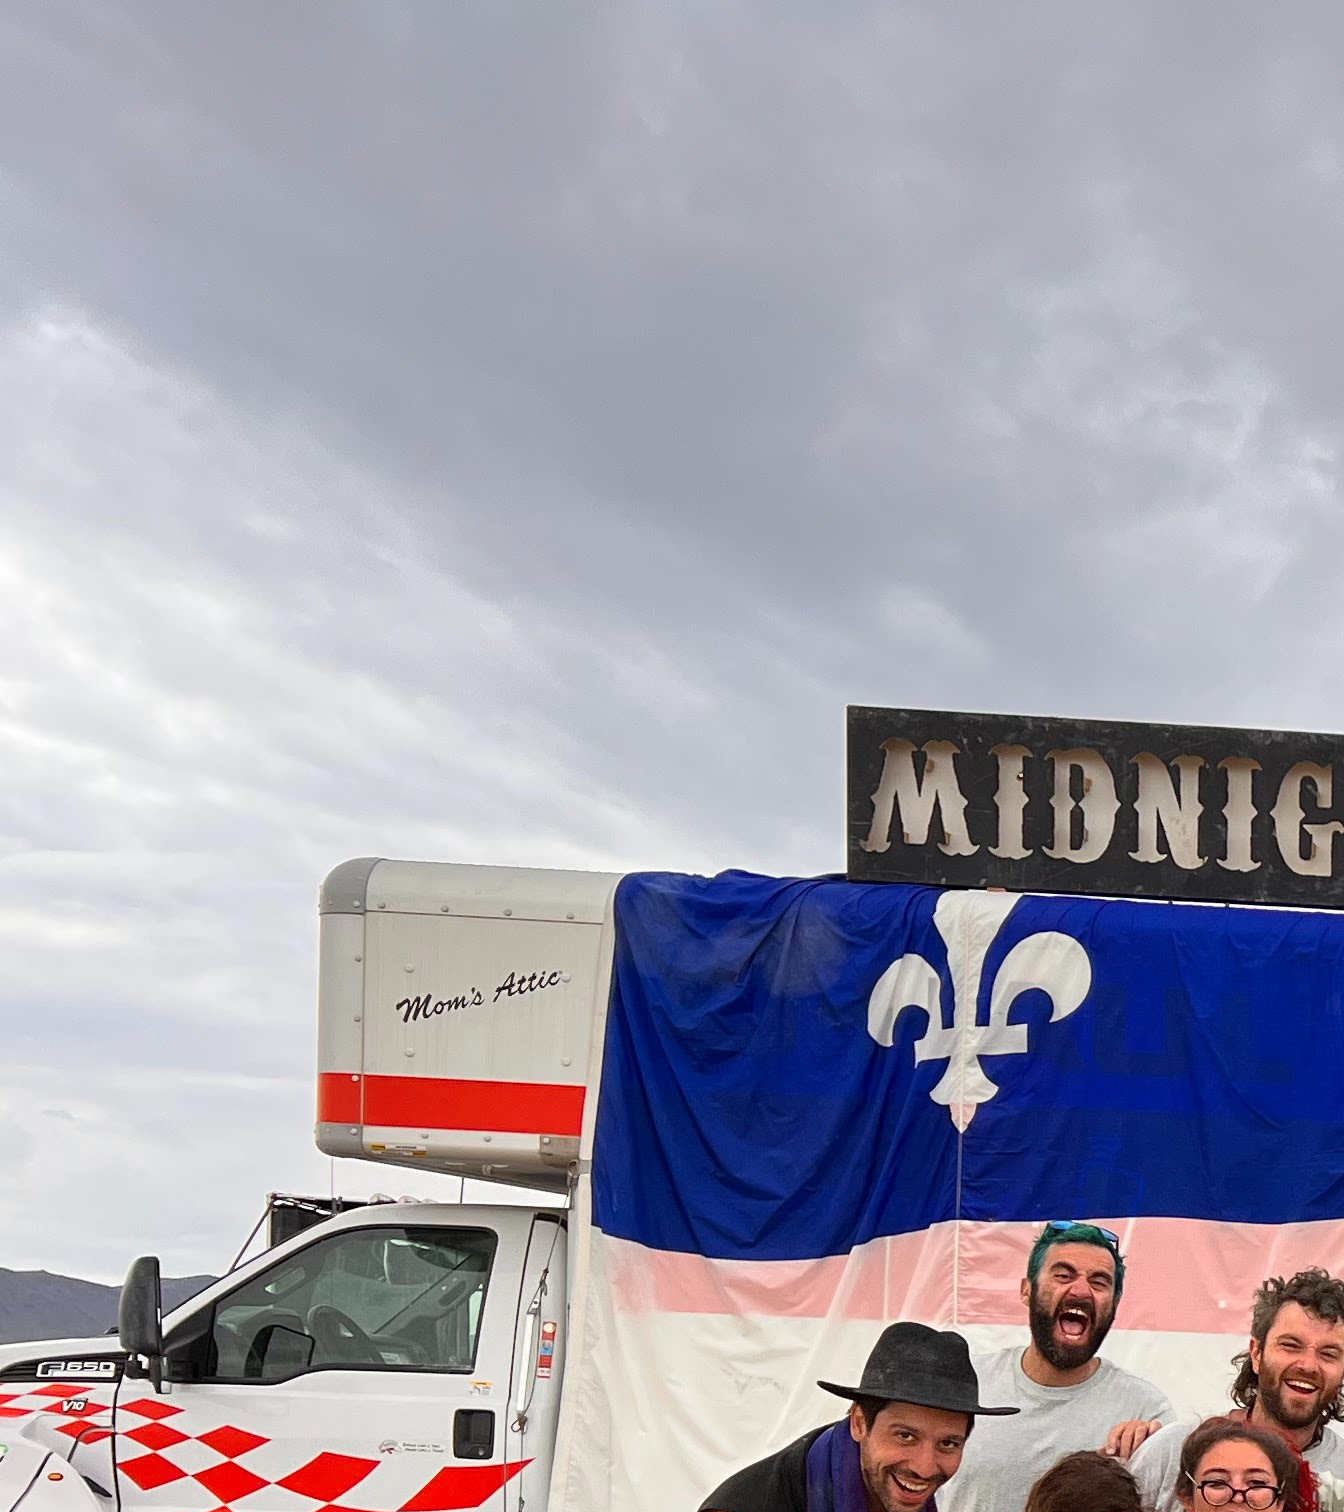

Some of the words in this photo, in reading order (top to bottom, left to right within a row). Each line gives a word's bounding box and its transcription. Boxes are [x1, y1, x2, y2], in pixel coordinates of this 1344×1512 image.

[395, 986, 485, 1023] Mom's
[493, 970, 561, 1002] Attic
[62, 1400, 86, 1412] V10
